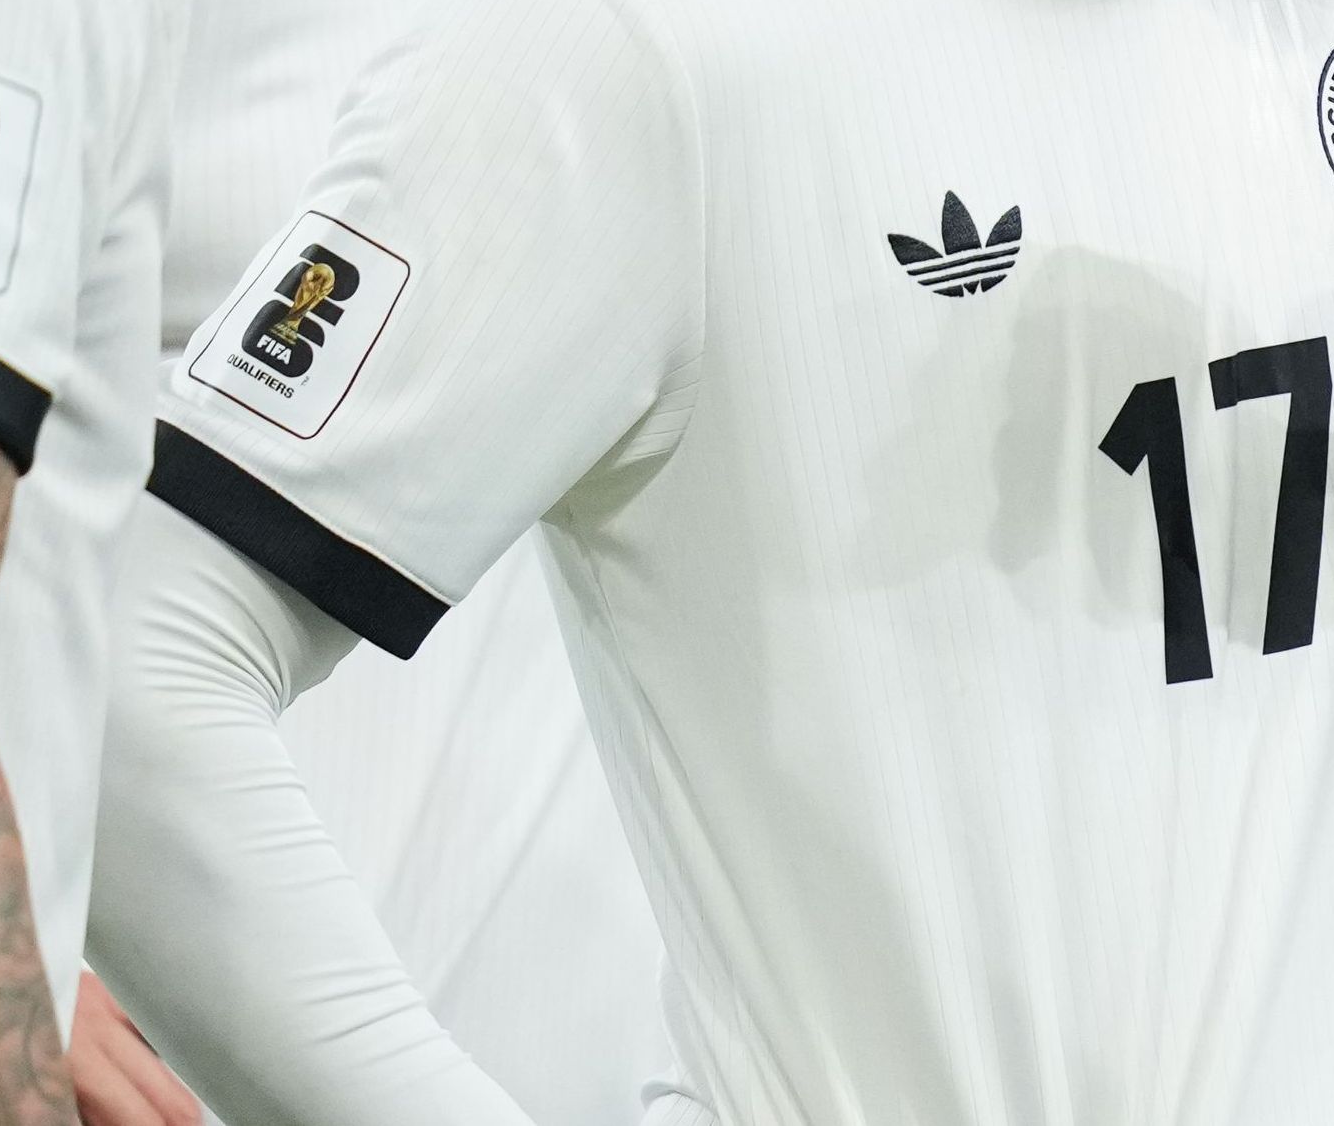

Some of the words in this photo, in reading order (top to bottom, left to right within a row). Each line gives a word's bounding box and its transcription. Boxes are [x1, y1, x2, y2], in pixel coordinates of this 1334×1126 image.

[256, 333, 293, 365] FIFA
[226, 353, 295, 399] QUALIFIERS
[1098, 336, 1334, 685] 17
